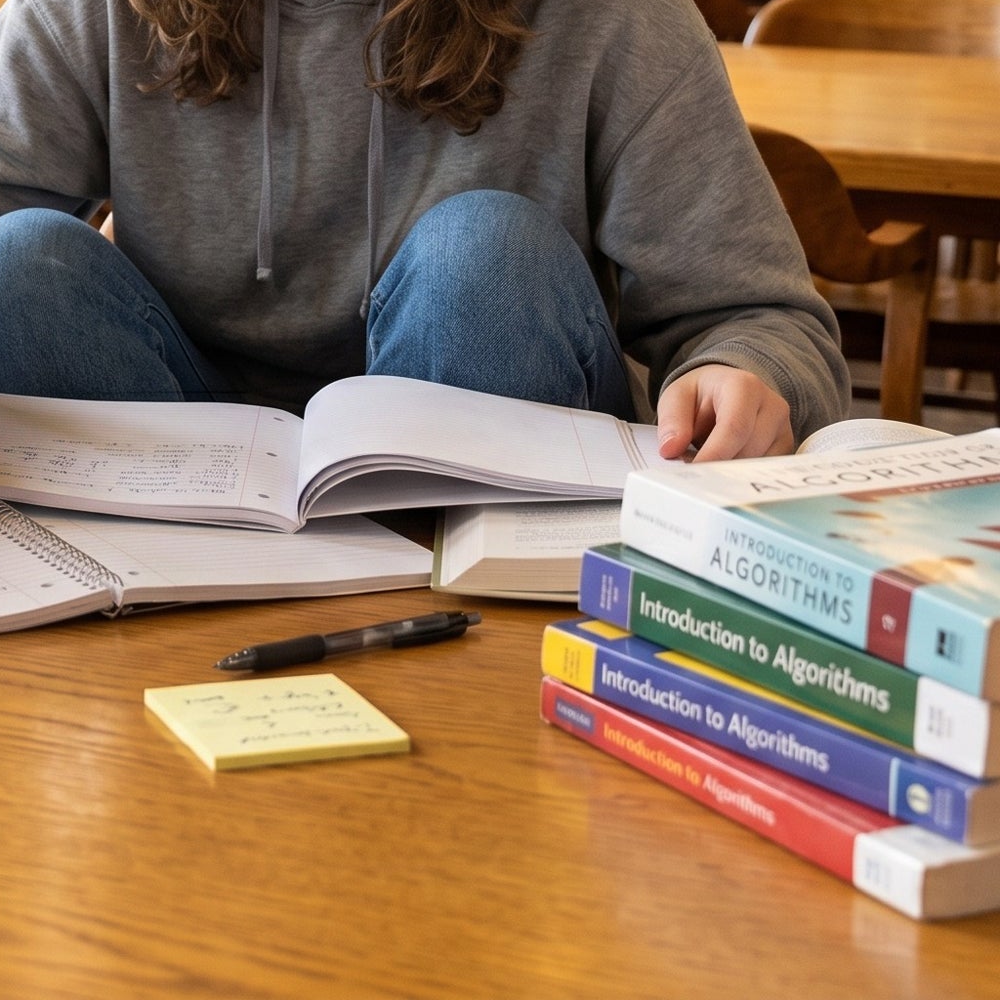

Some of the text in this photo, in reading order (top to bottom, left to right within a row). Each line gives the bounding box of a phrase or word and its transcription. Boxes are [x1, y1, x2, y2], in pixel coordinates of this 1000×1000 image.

[710, 547, 853, 626] ALGORITHMS
[725, 528, 854, 593] INTRODUCTION TO
[639, 592, 745, 655] Introduction
[749, 635, 769, 664] to
[772, 644, 891, 714] Algorithms
[601, 662, 701, 721] Introduction
[705, 704, 725, 731] to
[727, 712, 830, 773] Algorithms
[603, 722, 776, 827] Introduction to Algorithms
